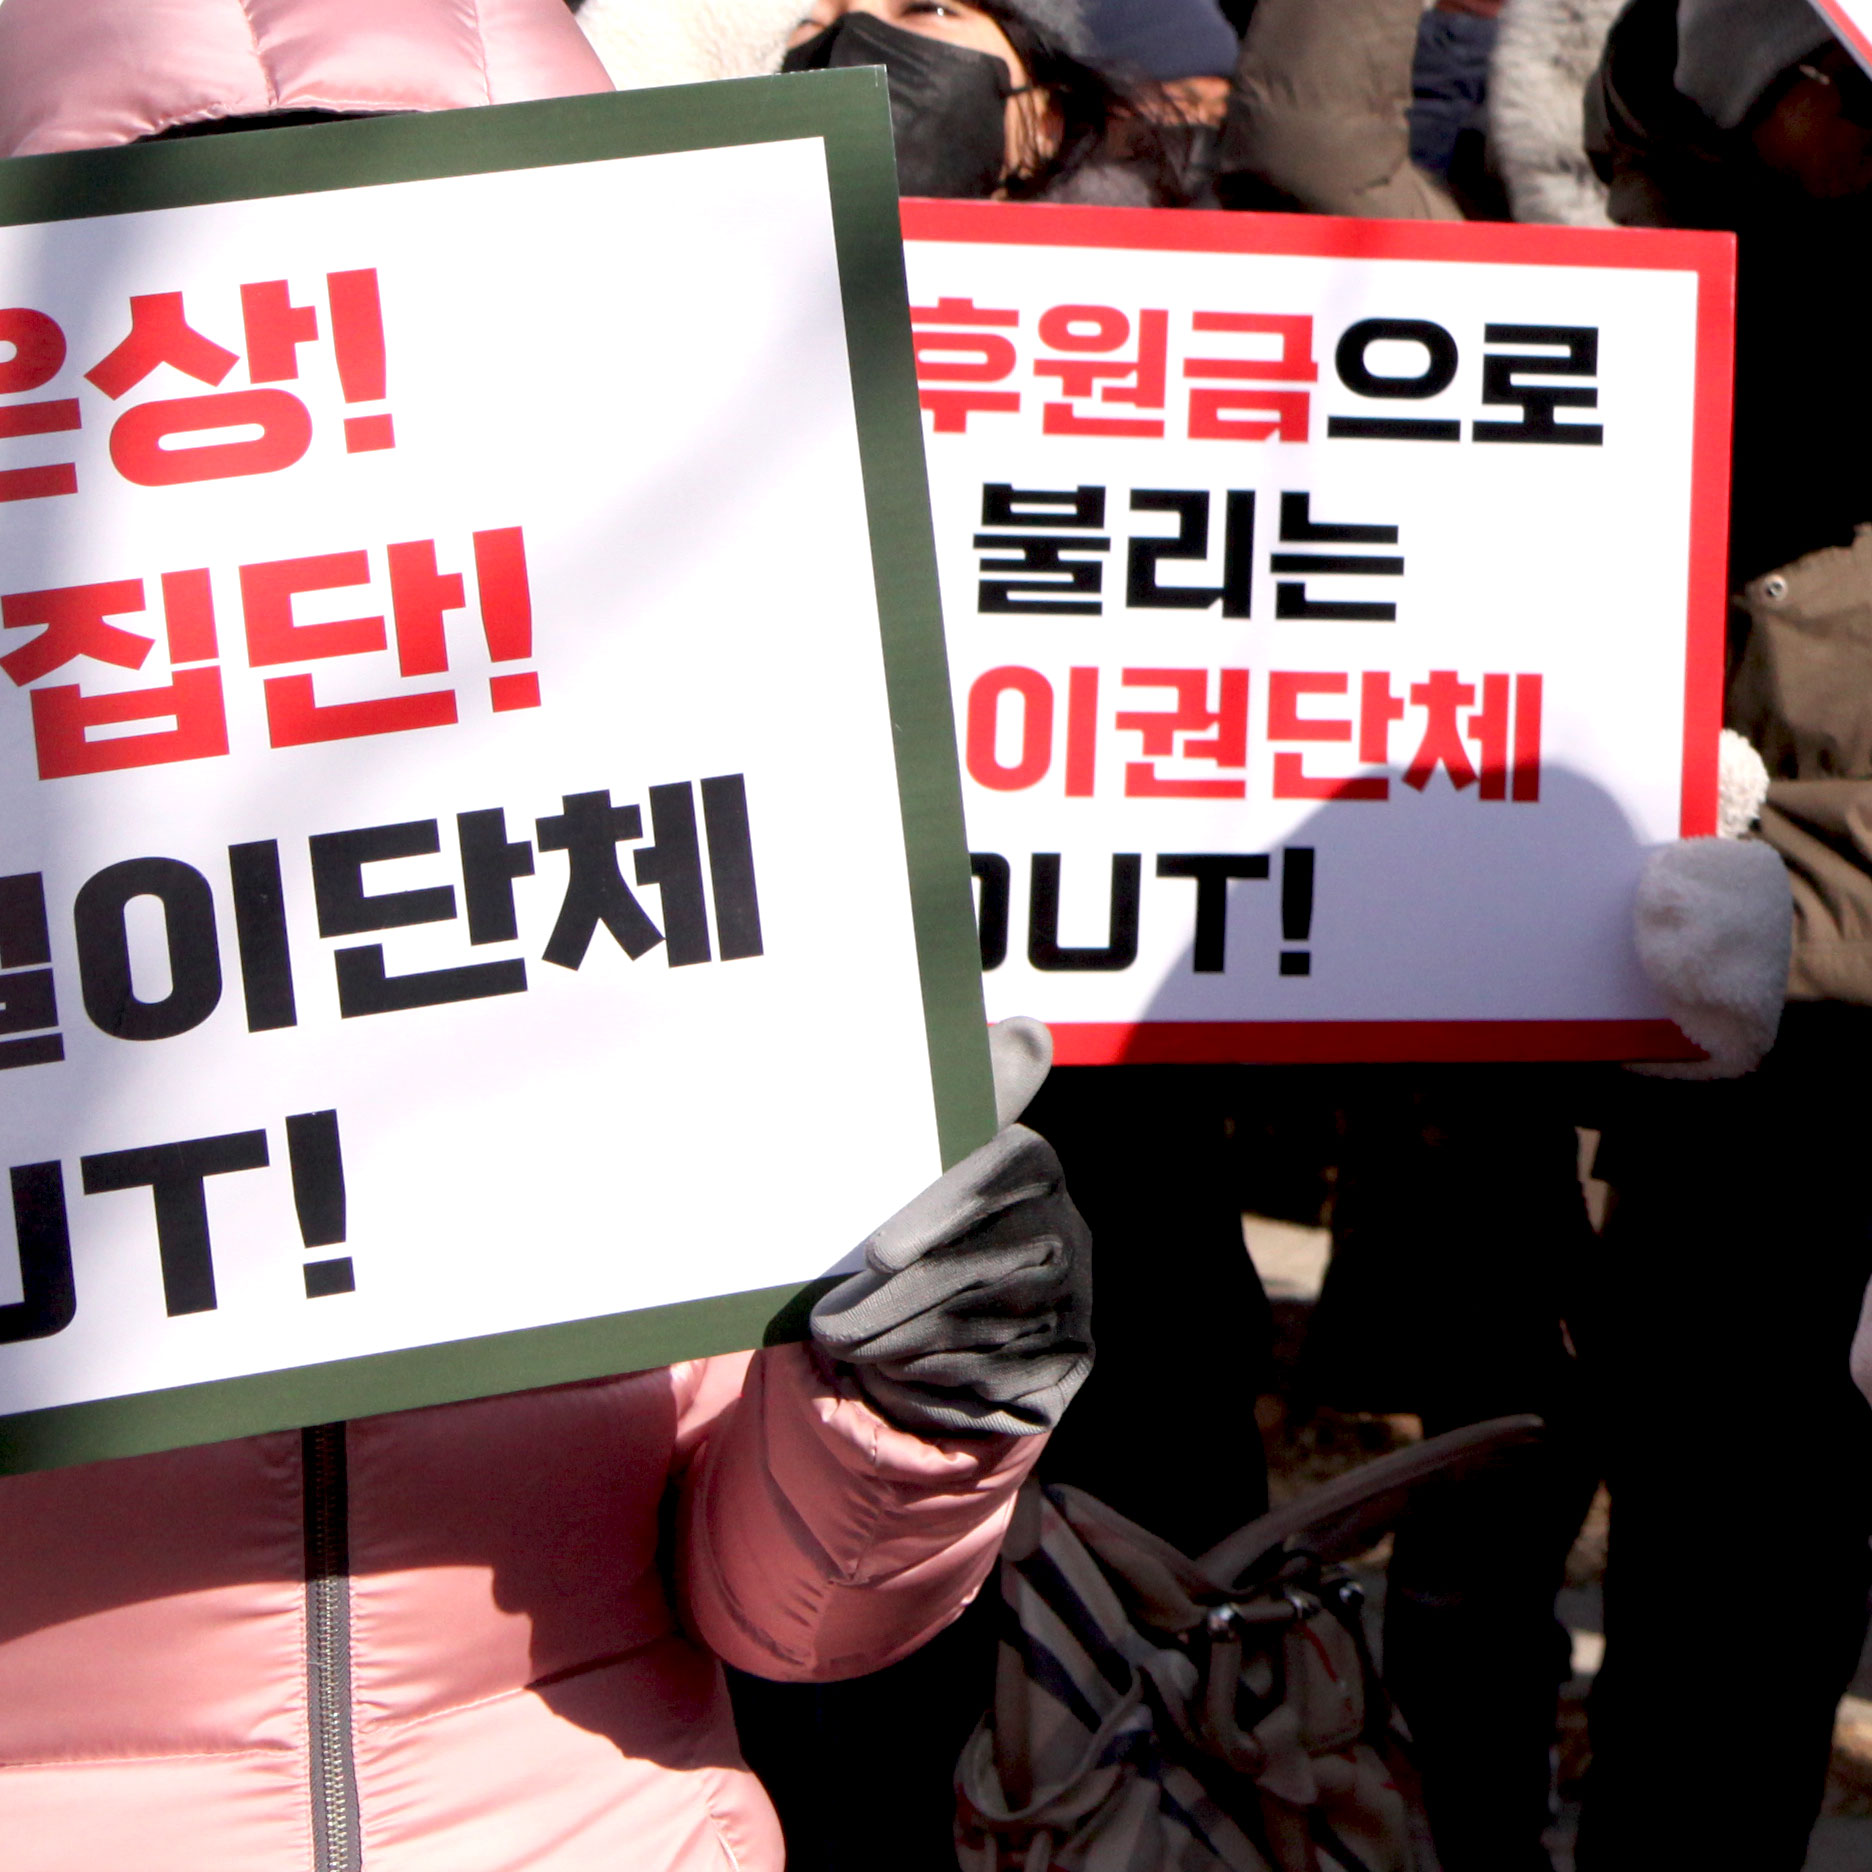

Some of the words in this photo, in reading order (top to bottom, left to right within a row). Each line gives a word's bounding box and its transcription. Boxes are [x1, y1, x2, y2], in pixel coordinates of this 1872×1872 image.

[973, 483, 1404, 622] 불리는
[0, 525, 541, 781] 집단!
[965, 665, 1543, 802] 이권단체
